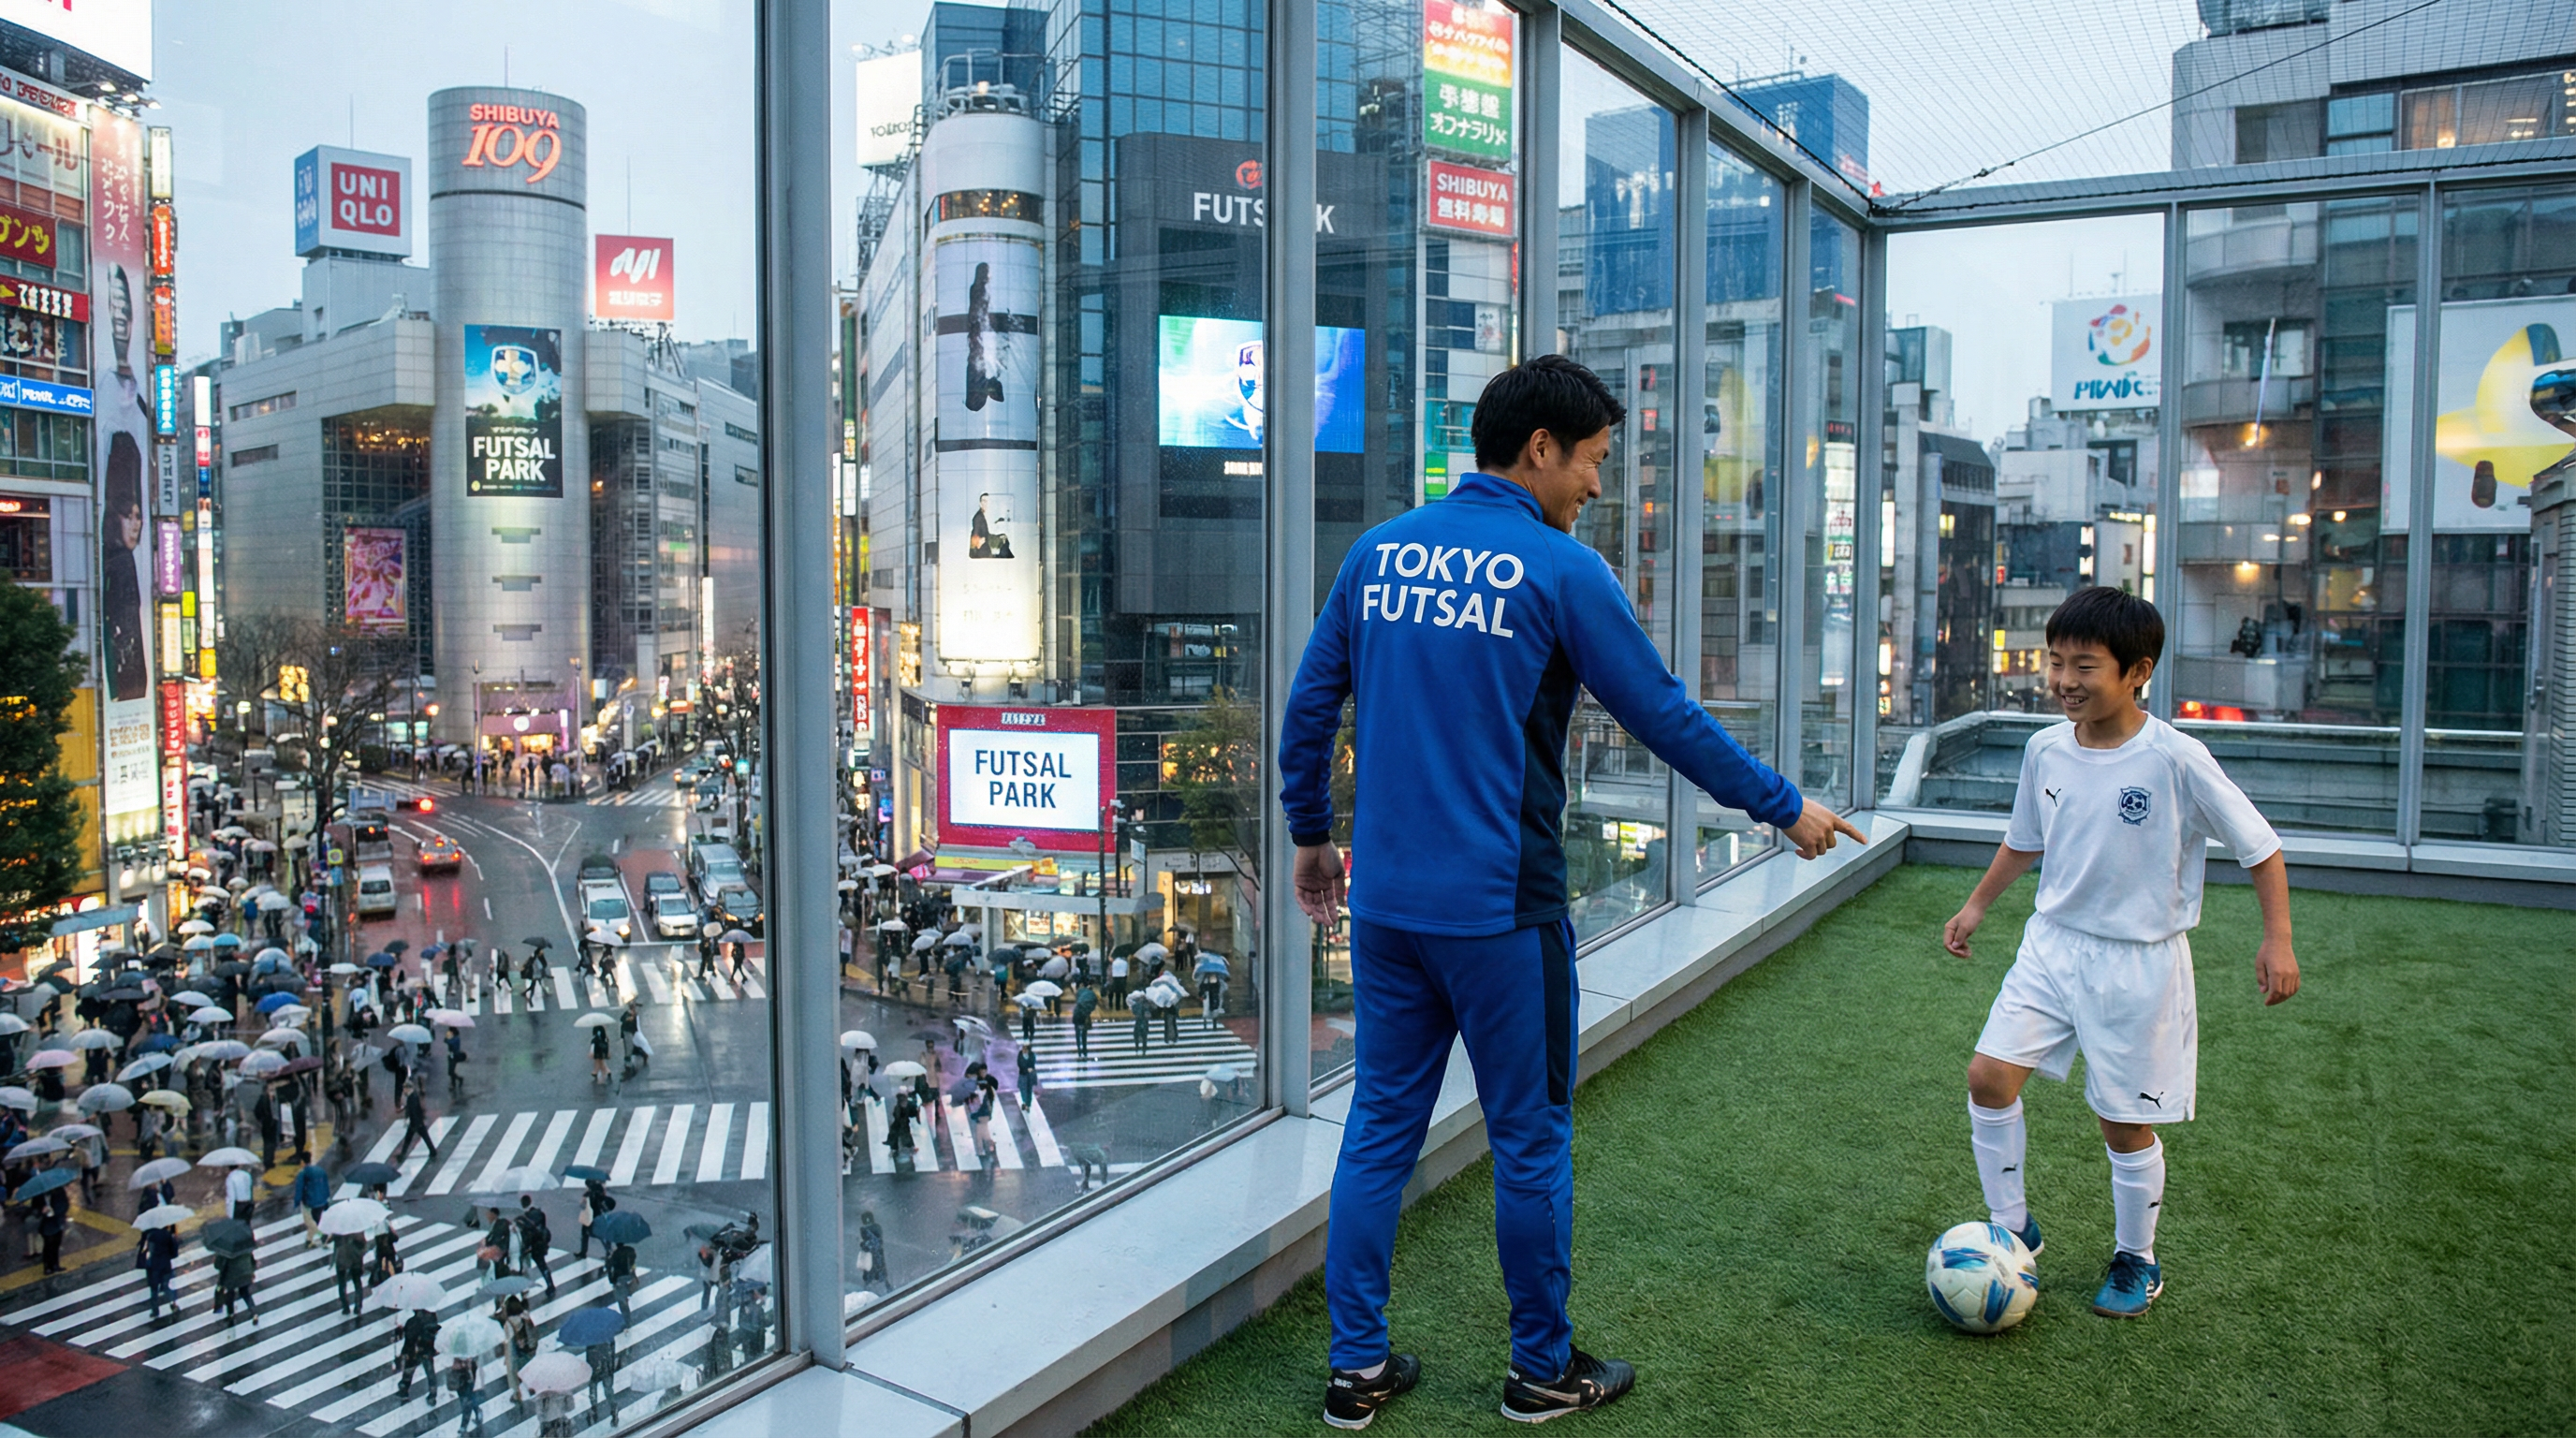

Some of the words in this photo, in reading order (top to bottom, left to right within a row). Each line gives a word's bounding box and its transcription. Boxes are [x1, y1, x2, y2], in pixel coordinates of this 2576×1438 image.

[470, 104, 560, 129] SHIBUYA
[462, 122, 562, 184] 109
[339, 171, 388, 200] UNI
[1436, 172, 1509, 201] SHIBUYA
[339, 199, 393, 227] QLO
[473, 435, 557, 460] FUTSAL
[485, 458, 547, 482] PARK
[1375, 542, 1524, 590] TOKYO
[1363, 583, 1515, 638] FUTSAL
[975, 749, 1073, 779] FUTSAL
[989, 781, 1057, 809] PARK
